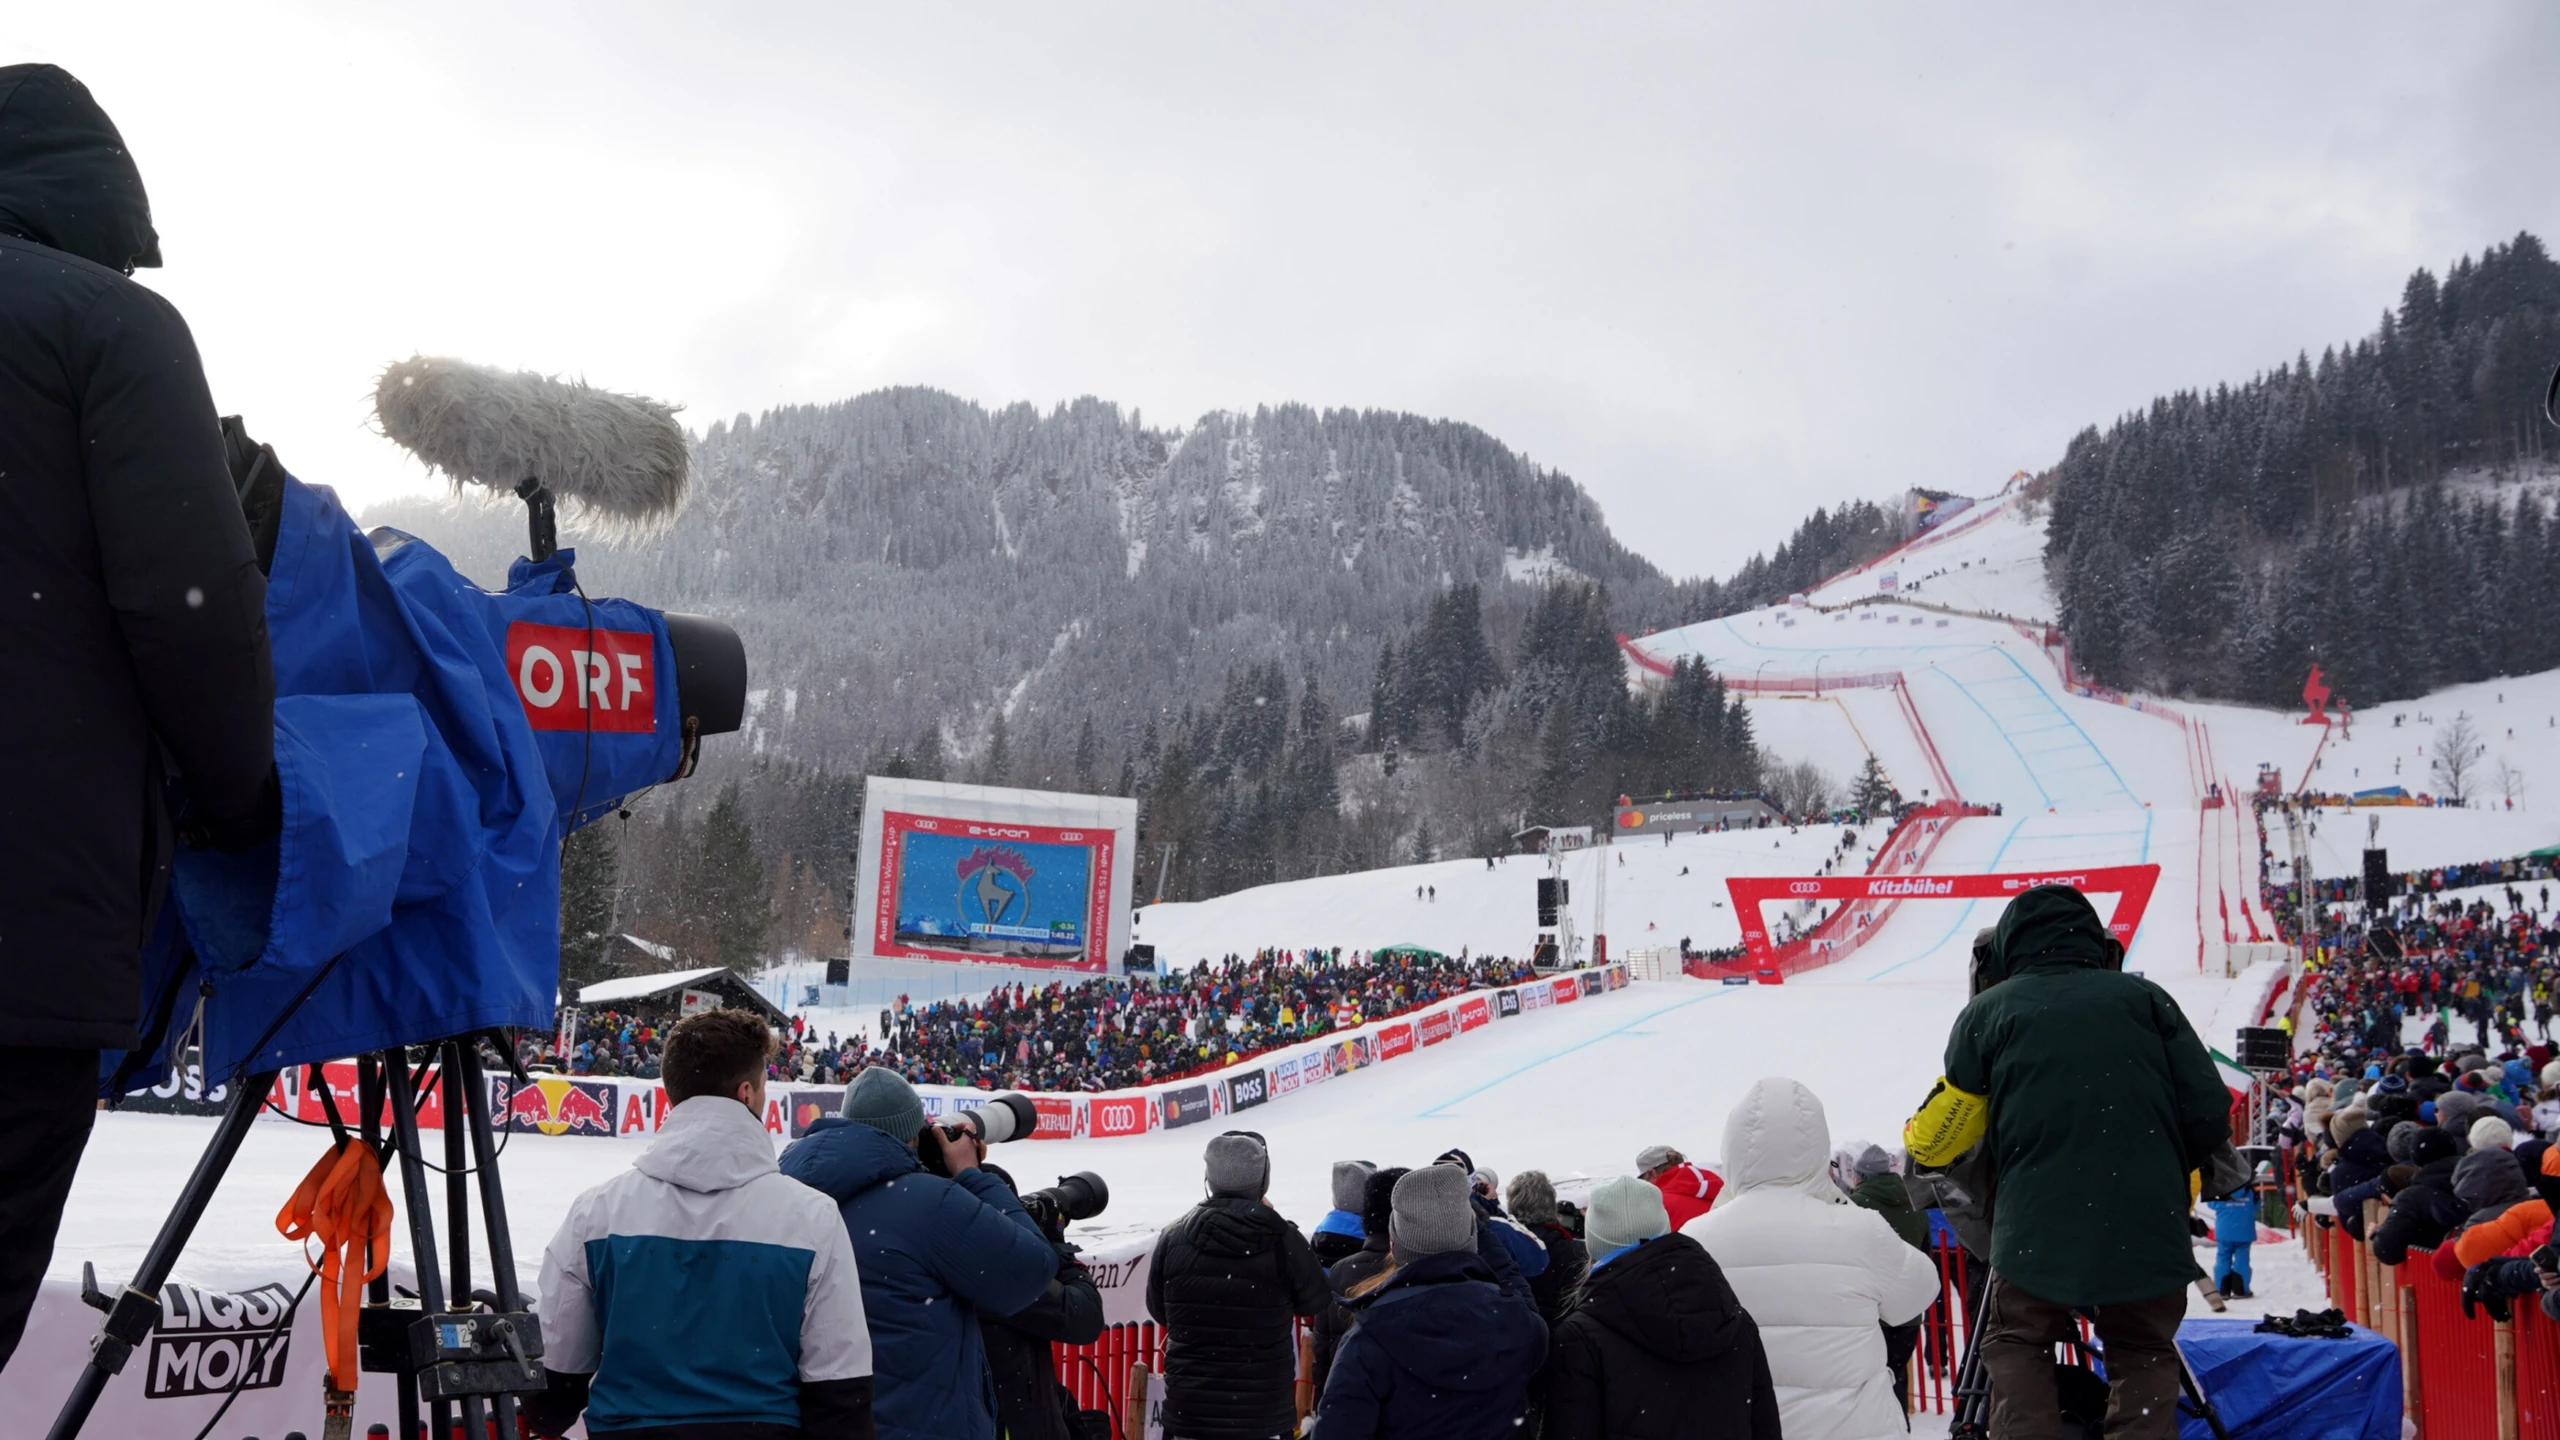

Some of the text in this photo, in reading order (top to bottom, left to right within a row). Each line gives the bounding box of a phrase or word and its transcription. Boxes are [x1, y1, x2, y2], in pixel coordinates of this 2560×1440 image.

[519, 645, 644, 711] ORF
[968, 826, 1030, 839] e-tron
[1649, 811, 1692, 823] priceless
[1101, 843, 1109, 868] Audi
[879, 826, 897, 942] Audi FIS Ski World Cup
[1867, 878, 1954, 895] Kitzbühel
[1096, 906, 1105, 937] World
[1501, 993, 1517, 1011] BOSS
[1181, 1098, 1208, 1112] mastercard
[1235, 1078, 1262, 1104] BOSS
[620, 1089, 653, 1134] A1
[765, 1095, 788, 1134] A1
[1074, 1102, 1089, 1136] A1
[1148, 1096, 1163, 1130] A1
[161, 1283, 293, 1330] LIQUI
[155, 1336, 288, 1394] MOLY
